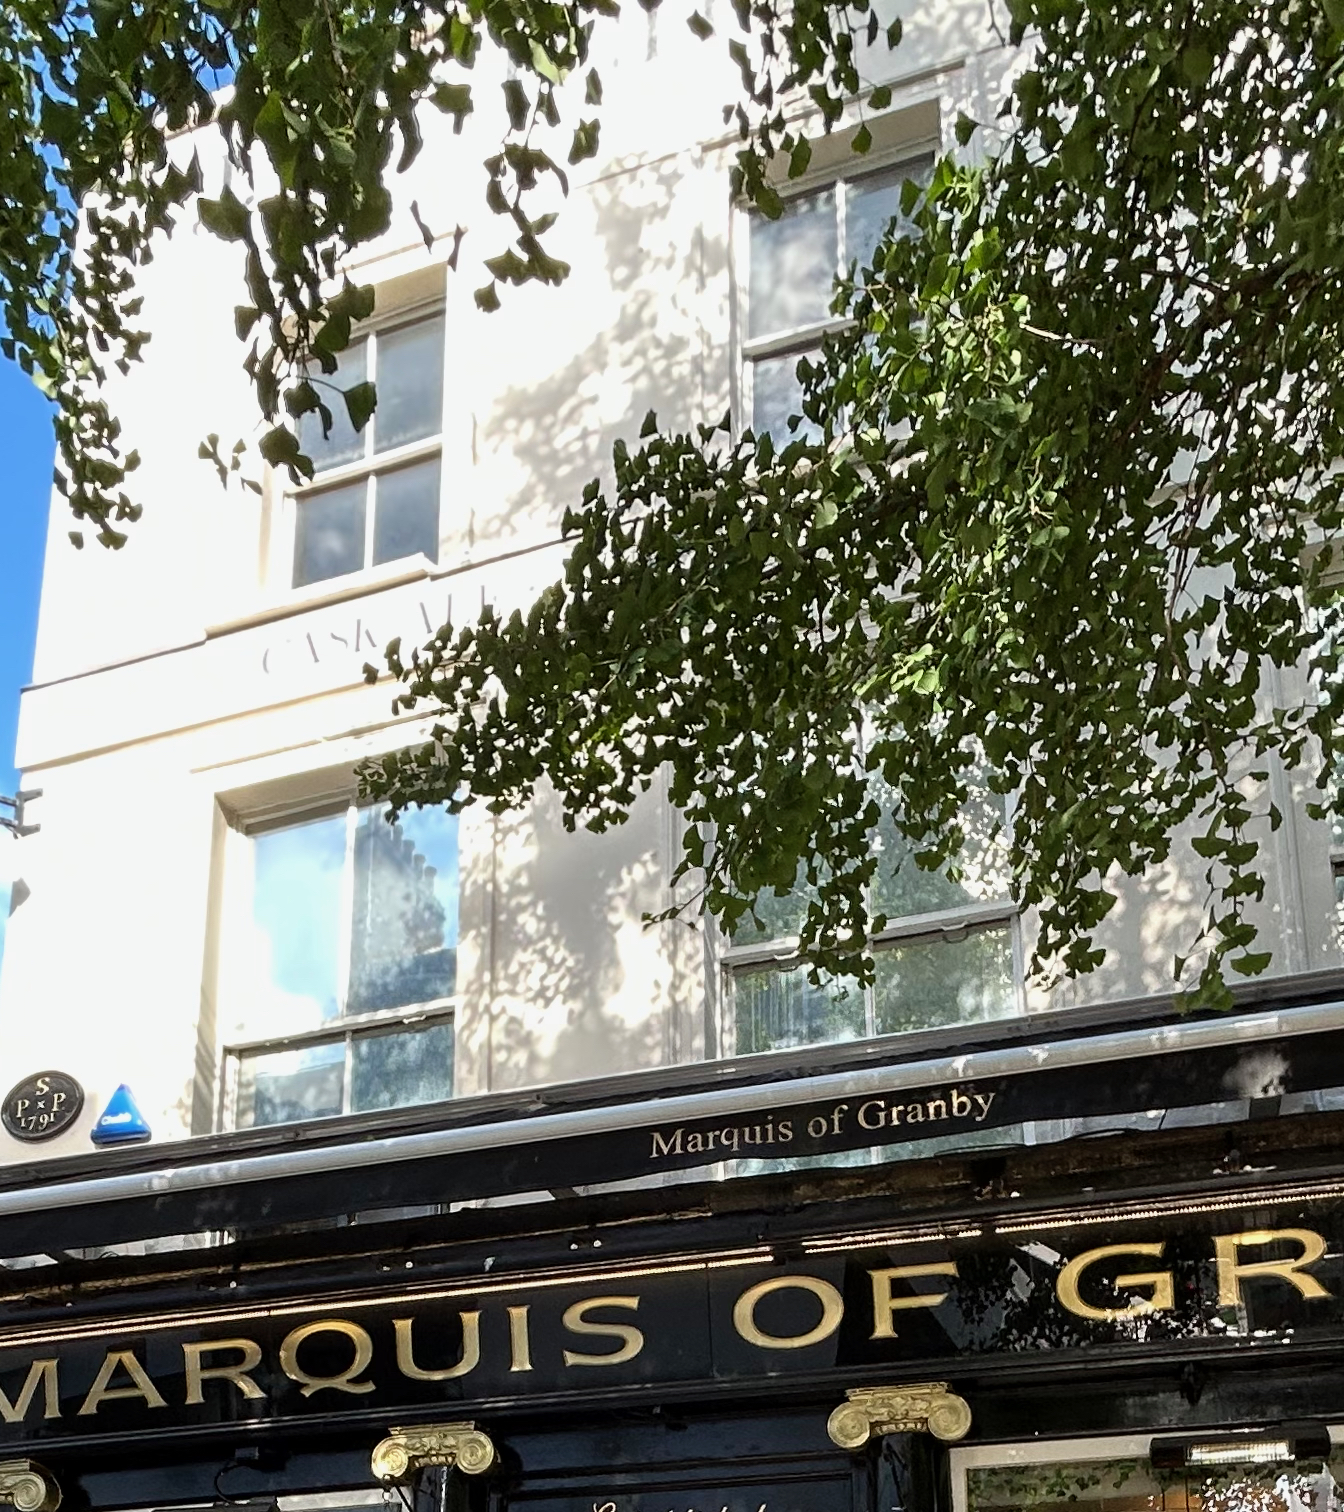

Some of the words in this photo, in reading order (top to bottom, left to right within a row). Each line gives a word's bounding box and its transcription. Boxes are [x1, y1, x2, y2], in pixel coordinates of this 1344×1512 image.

[36, 1077, 50, 1096] S
[20, 1112, 56, 1131] 1791
[648, 1115, 794, 1159] Marquis
[807, 1104, 849, 1139] of
[857, 1089, 997, 1131] Granby
[733, 1262, 959, 1350] OF
